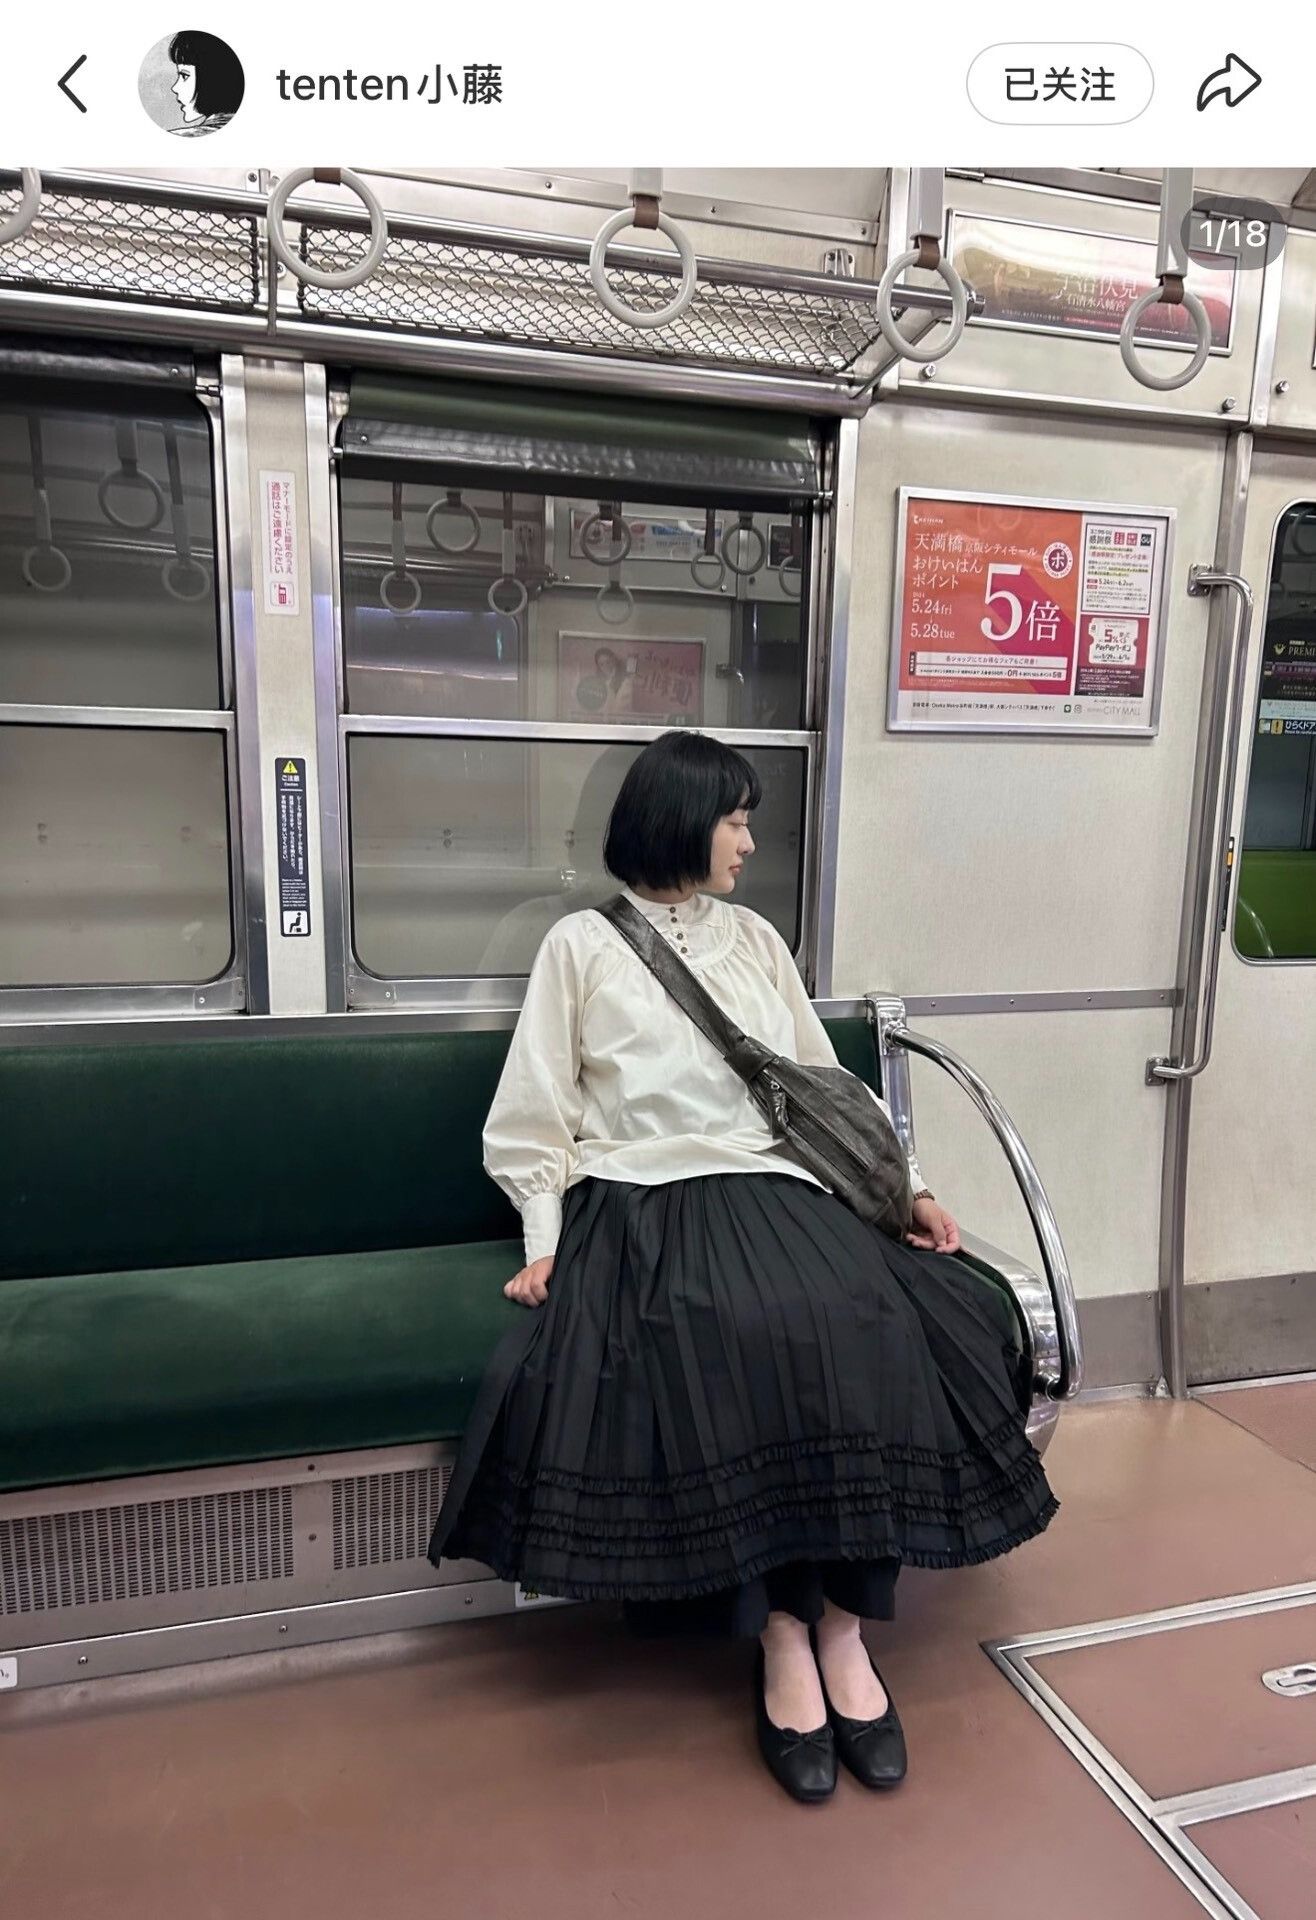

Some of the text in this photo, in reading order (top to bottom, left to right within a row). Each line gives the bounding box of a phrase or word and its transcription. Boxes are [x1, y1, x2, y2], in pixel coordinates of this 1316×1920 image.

[271, 481, 284, 574] 通話はご遠慮ください
[912, 555, 983, 574] おけいはん
[912, 572, 959, 590] ポイント
